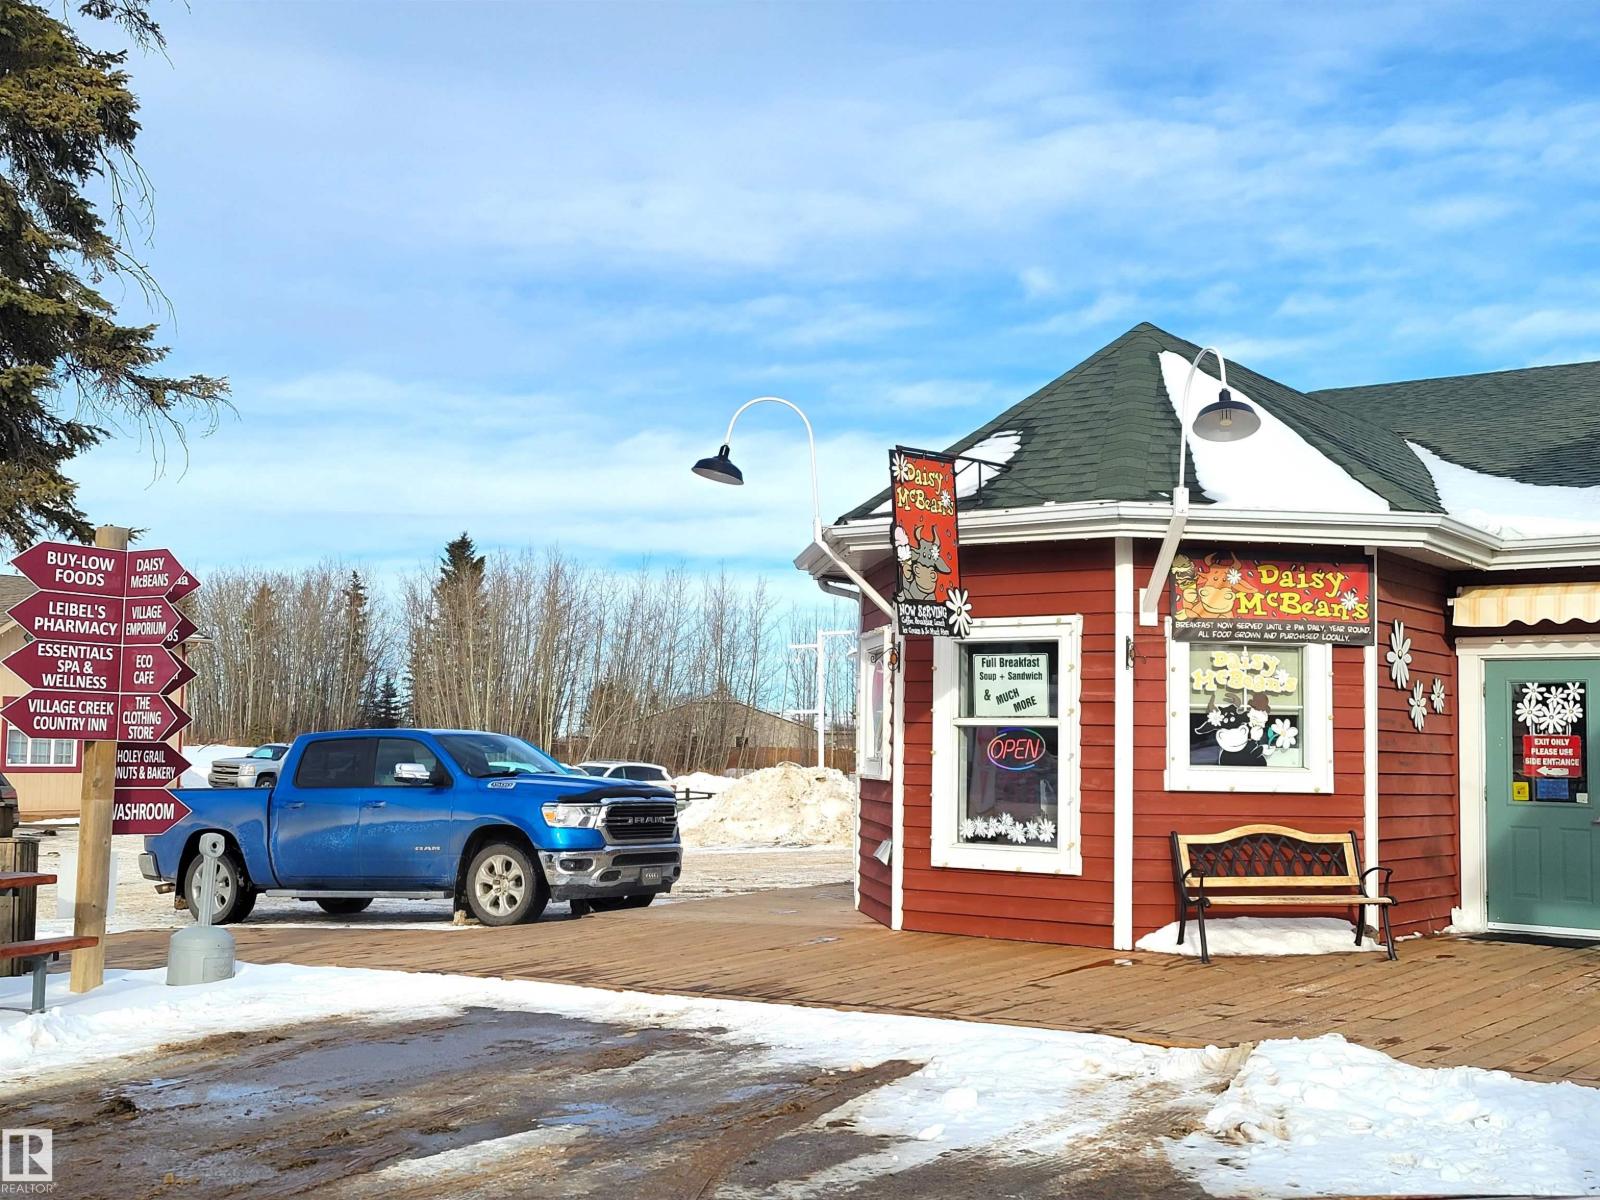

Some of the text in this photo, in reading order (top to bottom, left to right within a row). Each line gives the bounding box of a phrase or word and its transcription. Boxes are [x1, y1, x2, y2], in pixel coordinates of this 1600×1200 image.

[906, 463, 943, 495] Daisy
[47, 551, 115, 572] BUY-LOW
[136, 557, 165, 572] DAISY
[55, 569, 105, 587] FOODS
[130, 573, 169, 589] McBEANS
[1257, 564, 1345, 598] Daisy
[48, 601, 106, 619] LEIBEL'S
[131, 605, 163, 619] VILLAGE
[898, 603, 947, 619] NOW SERVING
[34, 616, 119, 636] PHARMACY
[125, 622, 167, 636] EMPORIUM
[1280, 632, 1320, 640] PURCHASED
[37, 643, 114, 660] ESSENTIALS
[57, 660, 94, 674] SPA &
[136, 655, 153, 668] ECO
[981, 657, 1040, 668] Full Breakfast
[42, 673, 107, 689] WELLNESS
[133, 671, 154, 684] CAFE
[980, 672, 997, 681] Soup
[1008, 672, 1043, 680] Sandwich
[135, 696, 151, 710] THE
[984, 688, 1020, 705] & MUCH
[28, 698, 114, 716] VILLAGE CREEK
[1013, 696, 1037, 712] MORE
[33, 716, 107, 732] COUNTRY INN
[122, 711, 161, 725] CLOTHING
[128, 726, 154, 739] STORE
[991, 739, 1040, 759] OPEN
[1559, 748, 1573, 756] USE
[117, 750, 165, 763] HOLEY GRAIL
[1525, 757, 1579, 766] SIDE ENTRANCE
[115, 766, 176, 779] NUTS & BAKERY
[634, 816, 664, 824] RAM
